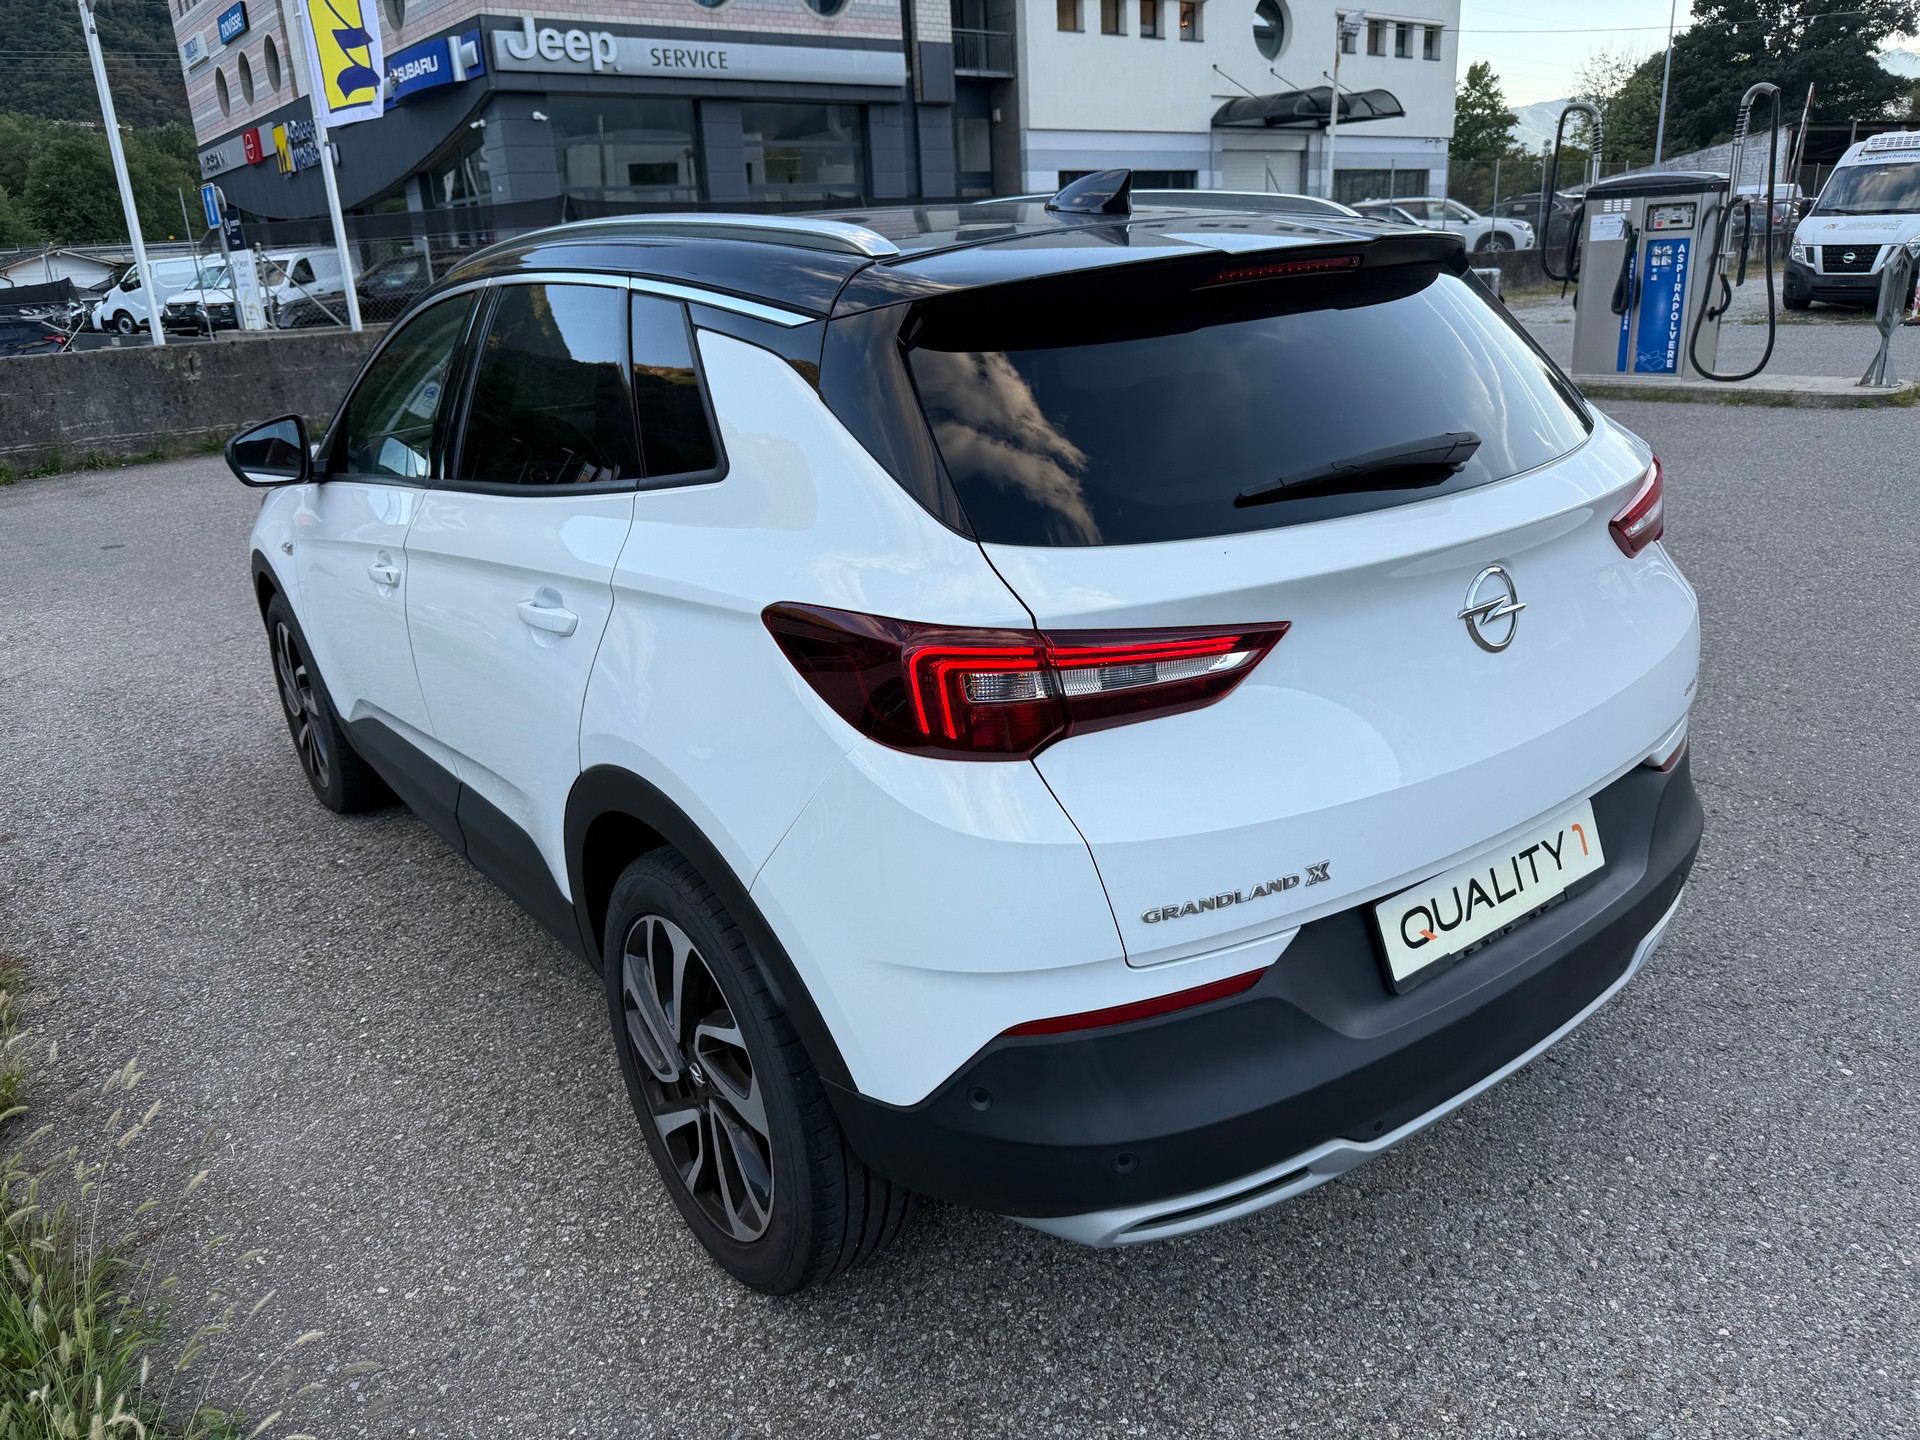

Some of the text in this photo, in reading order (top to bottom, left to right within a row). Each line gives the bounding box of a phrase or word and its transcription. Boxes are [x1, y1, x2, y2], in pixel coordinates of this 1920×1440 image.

[397, 54, 439, 83] SUBARU
[506, 16, 729, 71] Jeep SERVICE
[1666, 243, 1686, 369] ASPIRAPOLVERE
[1140, 858, 1332, 924] GRANDLAND X
[1400, 823, 1589, 950] QUALITY 1
